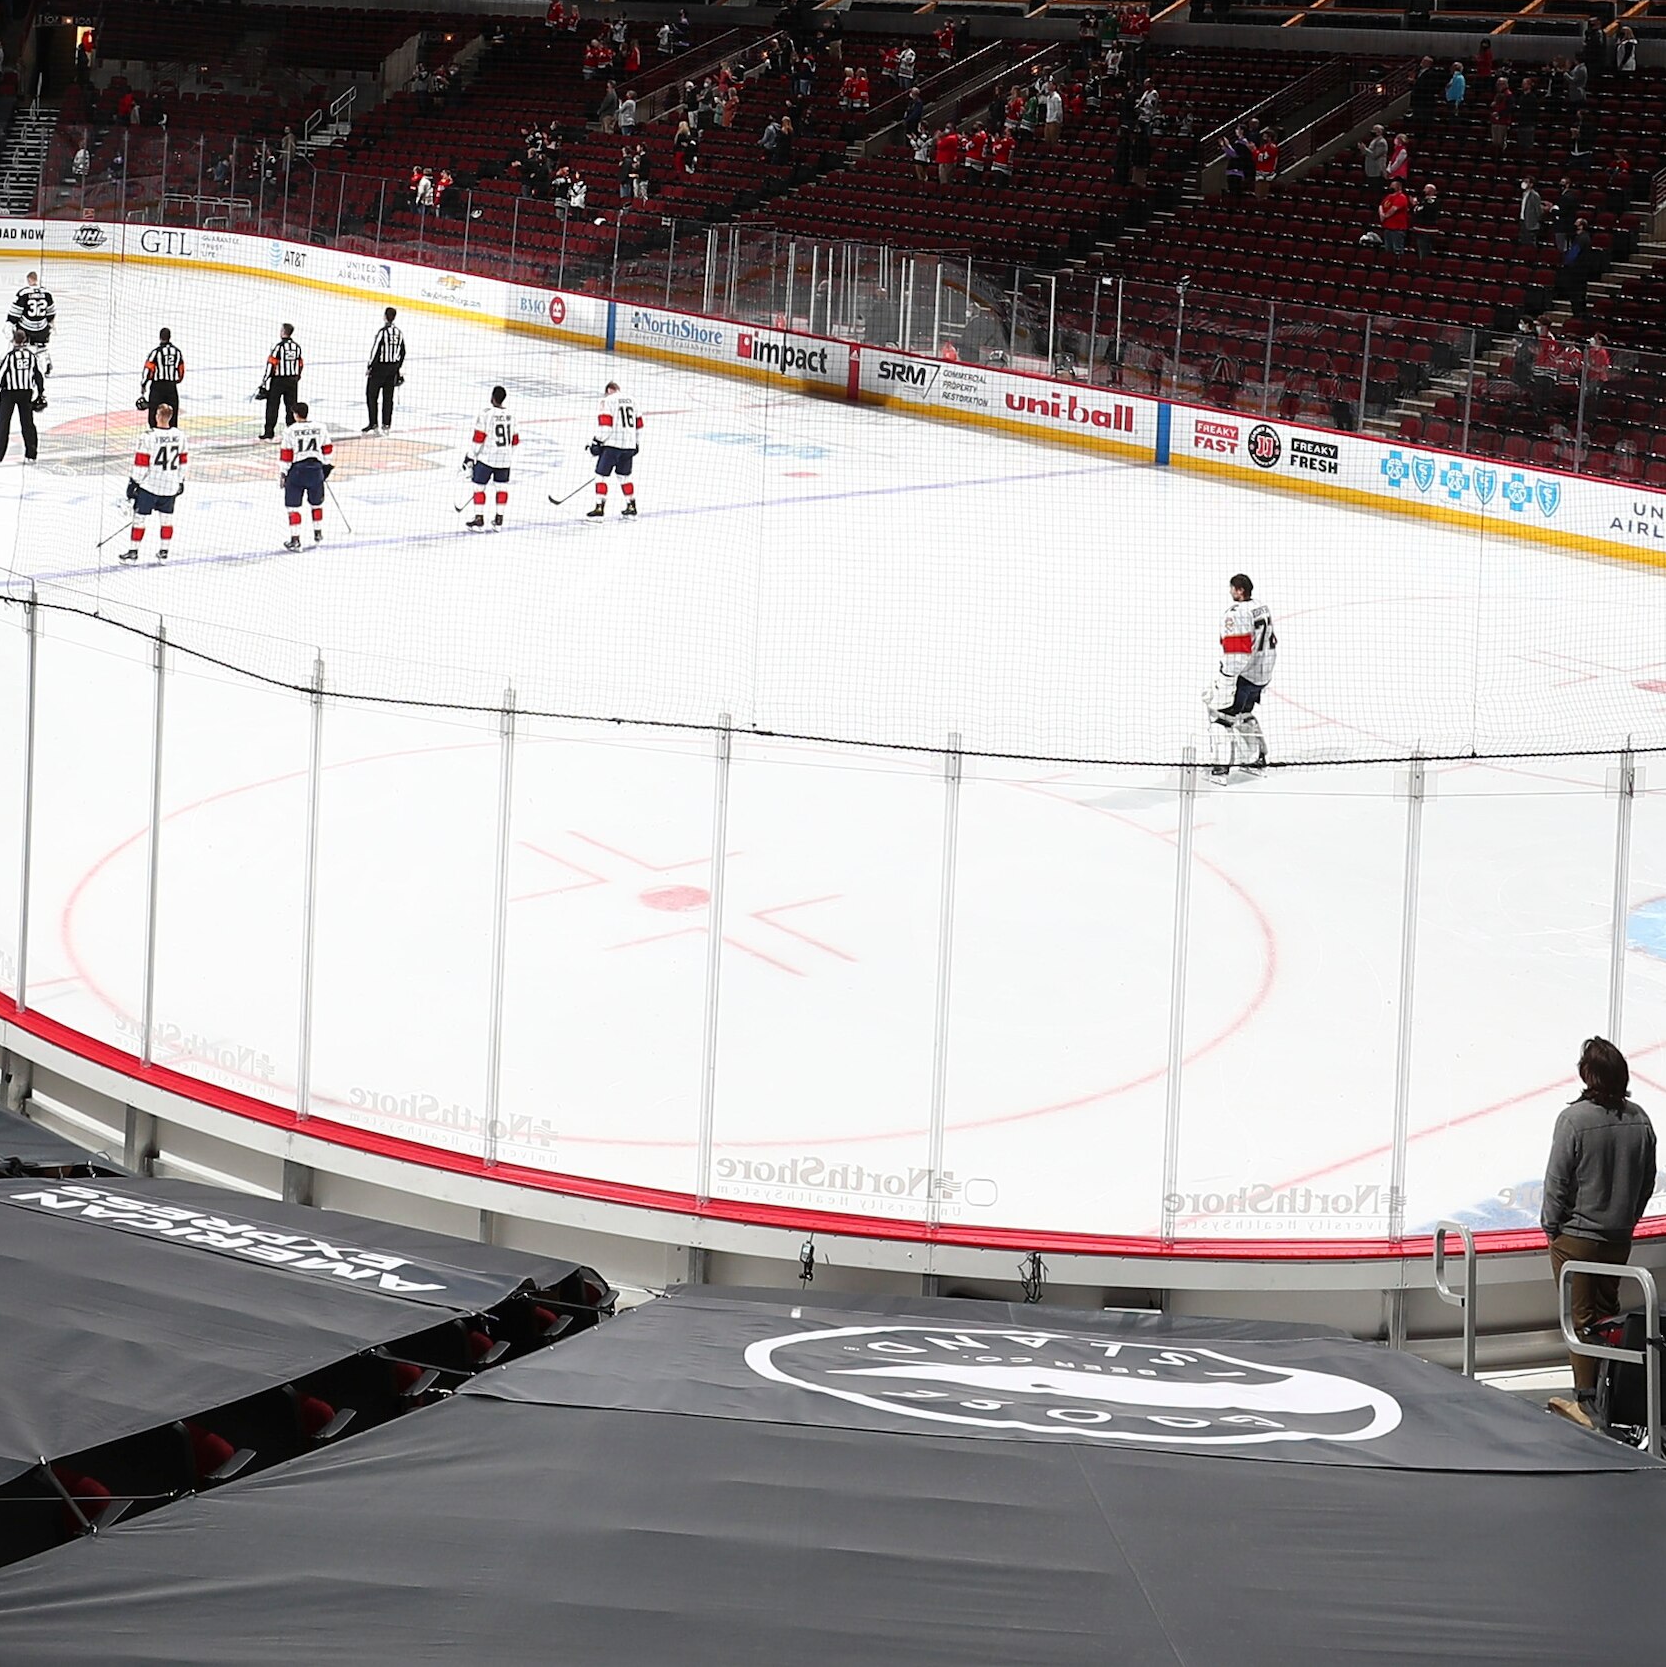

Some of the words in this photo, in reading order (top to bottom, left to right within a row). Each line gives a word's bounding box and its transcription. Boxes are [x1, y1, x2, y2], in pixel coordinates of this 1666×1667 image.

[21, 227, 45, 240] NOW
[73, 228, 107, 241] NHL
[141, 229, 193, 256] GTL
[283, 254, 307, 268] AT&T
[346, 261, 377, 273] UNITED
[337, 269, 376, 285] AIRLINES
[27, 299, 48, 317] 32
[519, 296, 546, 314] BMO
[642, 310, 723, 346] NorthShore
[165, 353, 175, 365] 12
[752, 330, 828, 376] impact
[16, 359, 29, 370] 82
[878, 360, 926, 386] SRM
[942, 368, 988, 385] COMMERCIAL
[941, 391, 989, 407] RESTORATION
[620, 405, 634, 429] 16
[1005, 392, 1133, 433] uni-ball
[495, 424, 511, 448] 91
[1197, 421, 1238, 437] FREAKY
[1194, 434, 1238, 454] FAST
[1292, 440, 1337, 459] FREAKY
[154, 445, 180, 470] 42
[1290, 454, 1339, 475] FRESH
[57, 1184, 418, 1272] EXPRESS
[9, 1190, 448, 1293] AMERICAN
[861, 1333, 1249, 1378] ISLAND
[882, 1388, 1287, 1430] GOOSE
